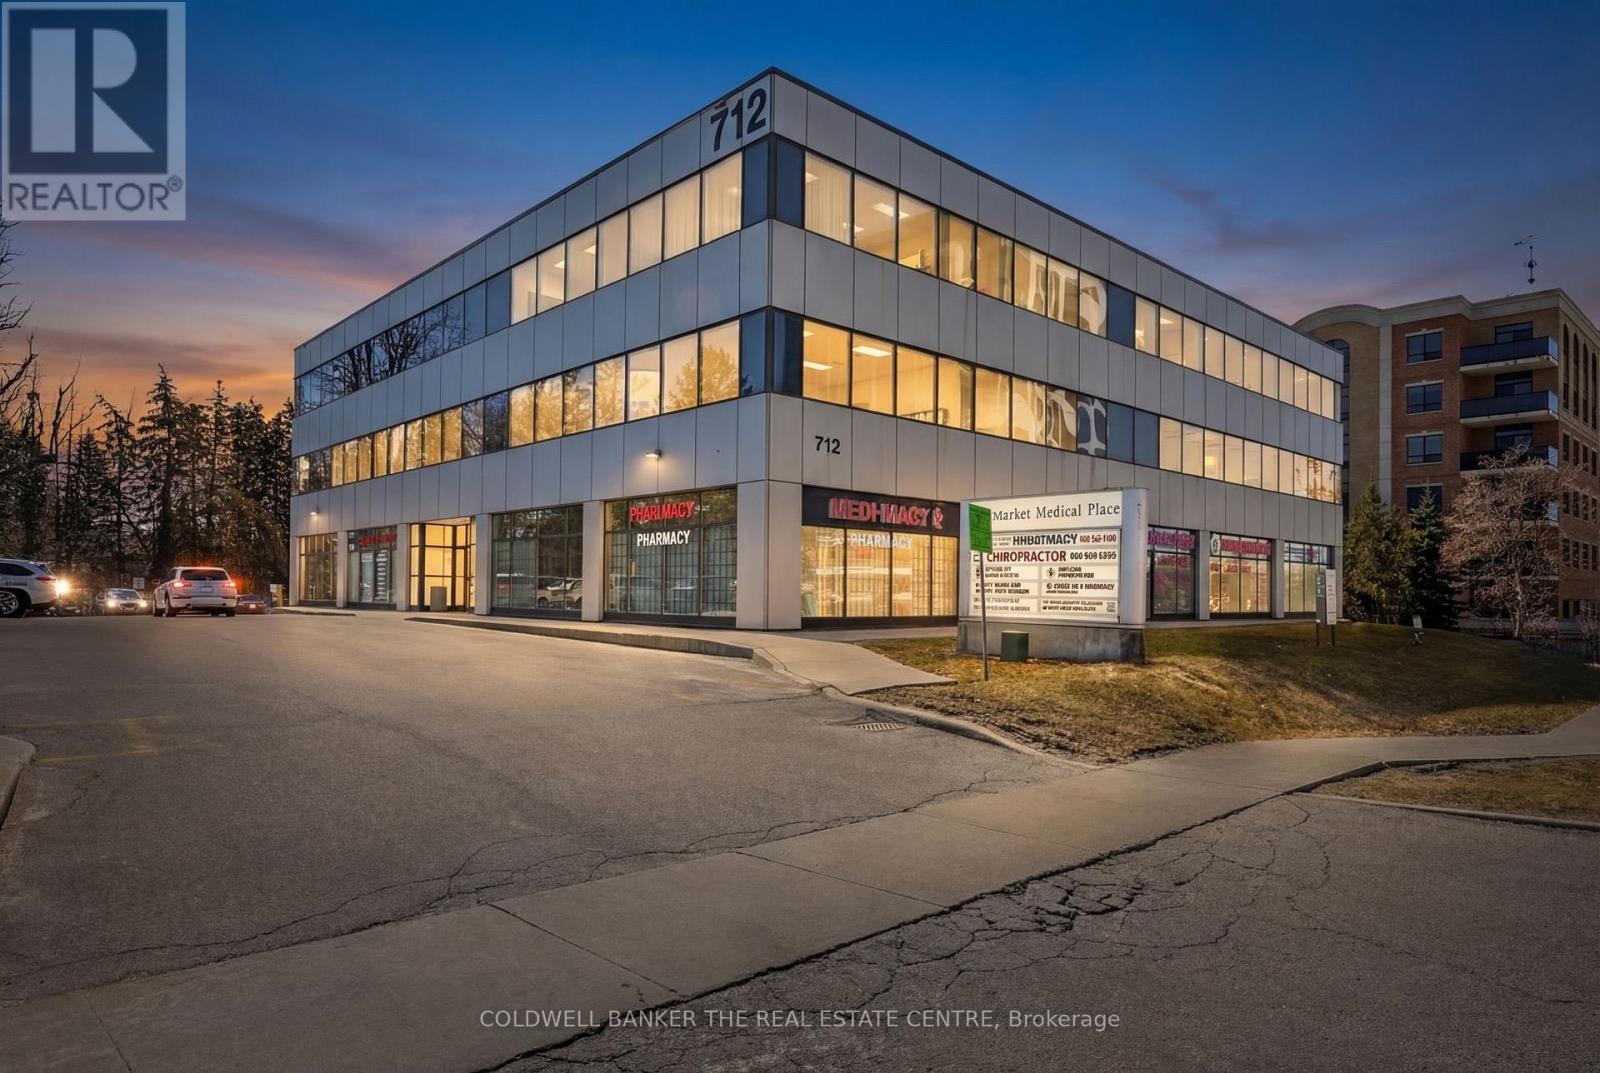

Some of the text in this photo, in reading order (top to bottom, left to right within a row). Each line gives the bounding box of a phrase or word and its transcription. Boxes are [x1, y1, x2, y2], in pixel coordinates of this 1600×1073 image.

[710, 87, 767, 152] 712
[815, 435, 841, 455] 712
[993, 508, 1031, 521] Market
[1036, 504, 1082, 519] Medical
[1088, 502, 1121, 516] Place
[637, 529, 691, 547] PHARMACY
[850, 532, 913, 550] PHARMACY
[986, 550, 1067, 563] CHIROPRACTOR
